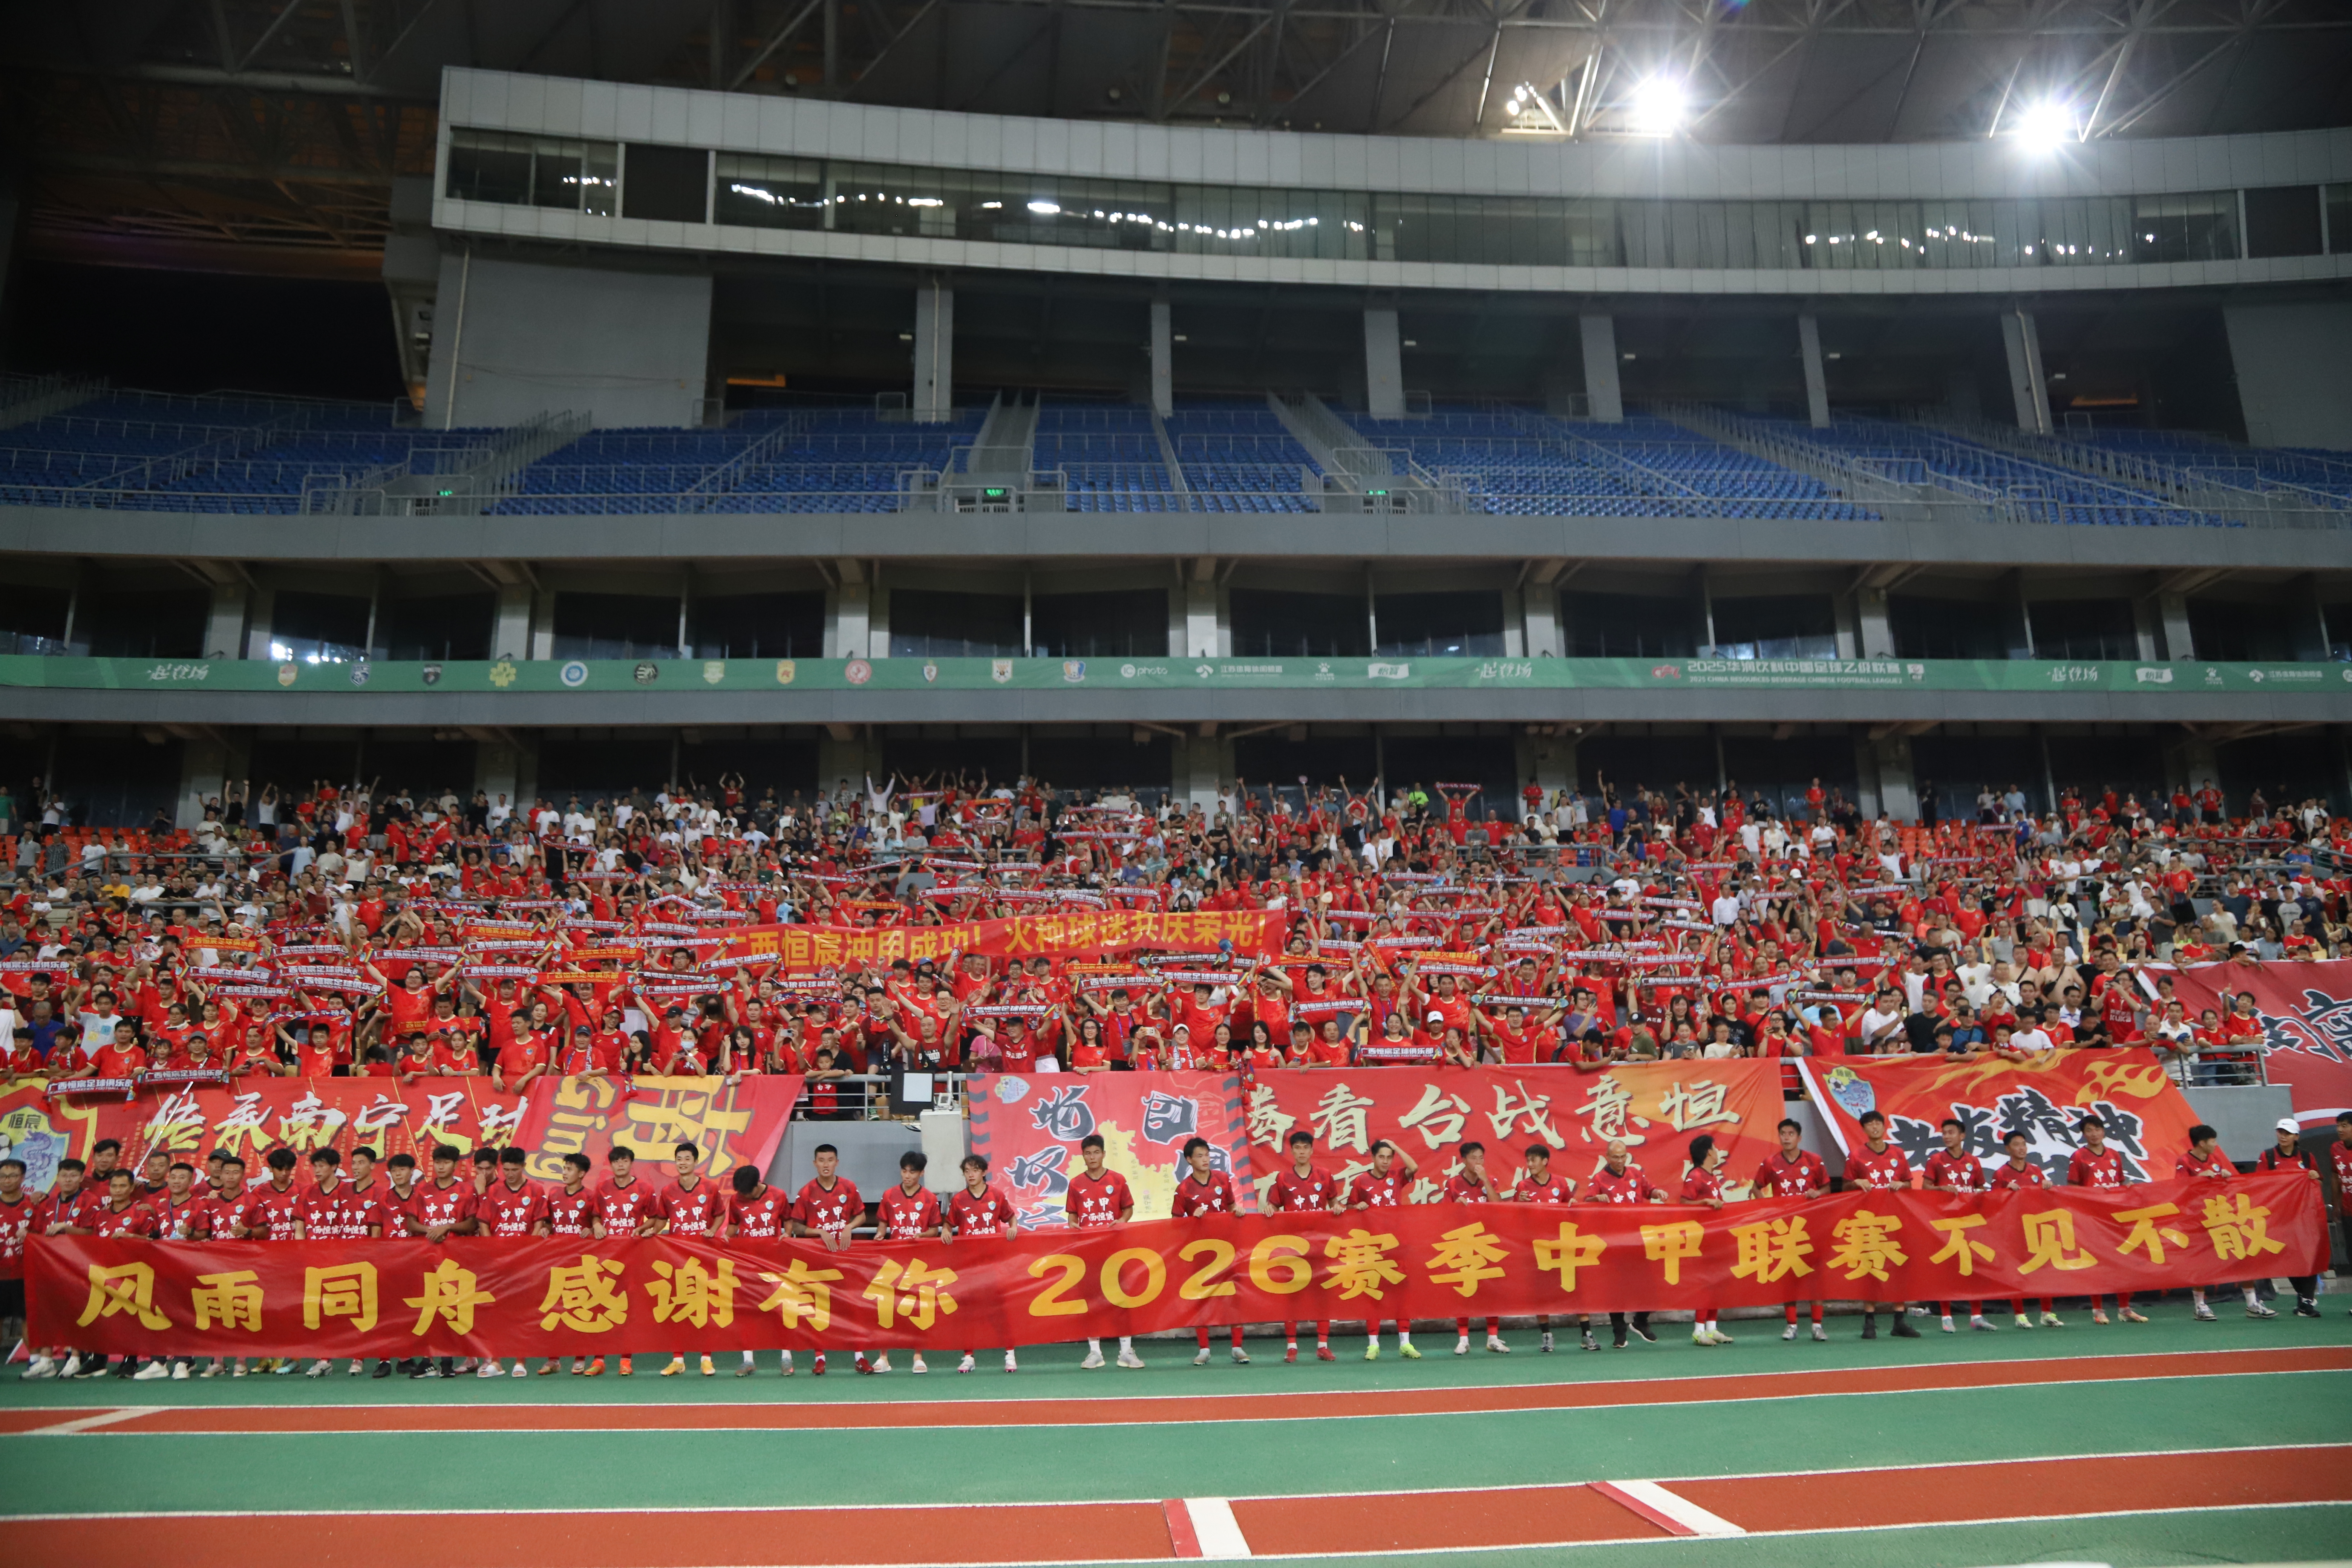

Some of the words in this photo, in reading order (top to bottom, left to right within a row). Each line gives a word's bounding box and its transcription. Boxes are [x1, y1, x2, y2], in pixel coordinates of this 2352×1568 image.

[1138, 667, 1168, 676] photo
[1004, 910, 1265, 953] 火种球迷共庆荣光！
[1081, 976, 1164, 987] 广西恒宸足球俱乐部
[967, 1005, 1046, 1014] 广西恒宸足球俱乐部
[1870, 1169, 1895, 1184] 中甲
[1947, 1170, 1971, 1184] 中甲
[2093, 1168, 2117, 1182] 中甲
[1780, 1178, 1806, 1191] 中甲
[1294, 1193, 1320, 1209] 中甲
[1371, 1189, 1393, 1206] 中甲
[1614, 1190, 1636, 1203] 中甲
[426, 1203, 455, 1218] 中甲
[606, 1202, 634, 1217] 中甲
[1083, 1197, 1110, 1213] 中甲
[311, 1210, 337, 1224] 中甲
[342, 1209, 366, 1224] 中甲
[501, 1207, 525, 1222] 中甲
[553, 1208, 580, 1223] 中甲
[676, 1205, 703, 1221] 中甲
[745, 1212, 772, 1228] 中甲
[817, 1206, 844, 1222] 中甲
[895, 1211, 920, 1227] 中甲
[967, 1212, 993, 1228] 中甲
